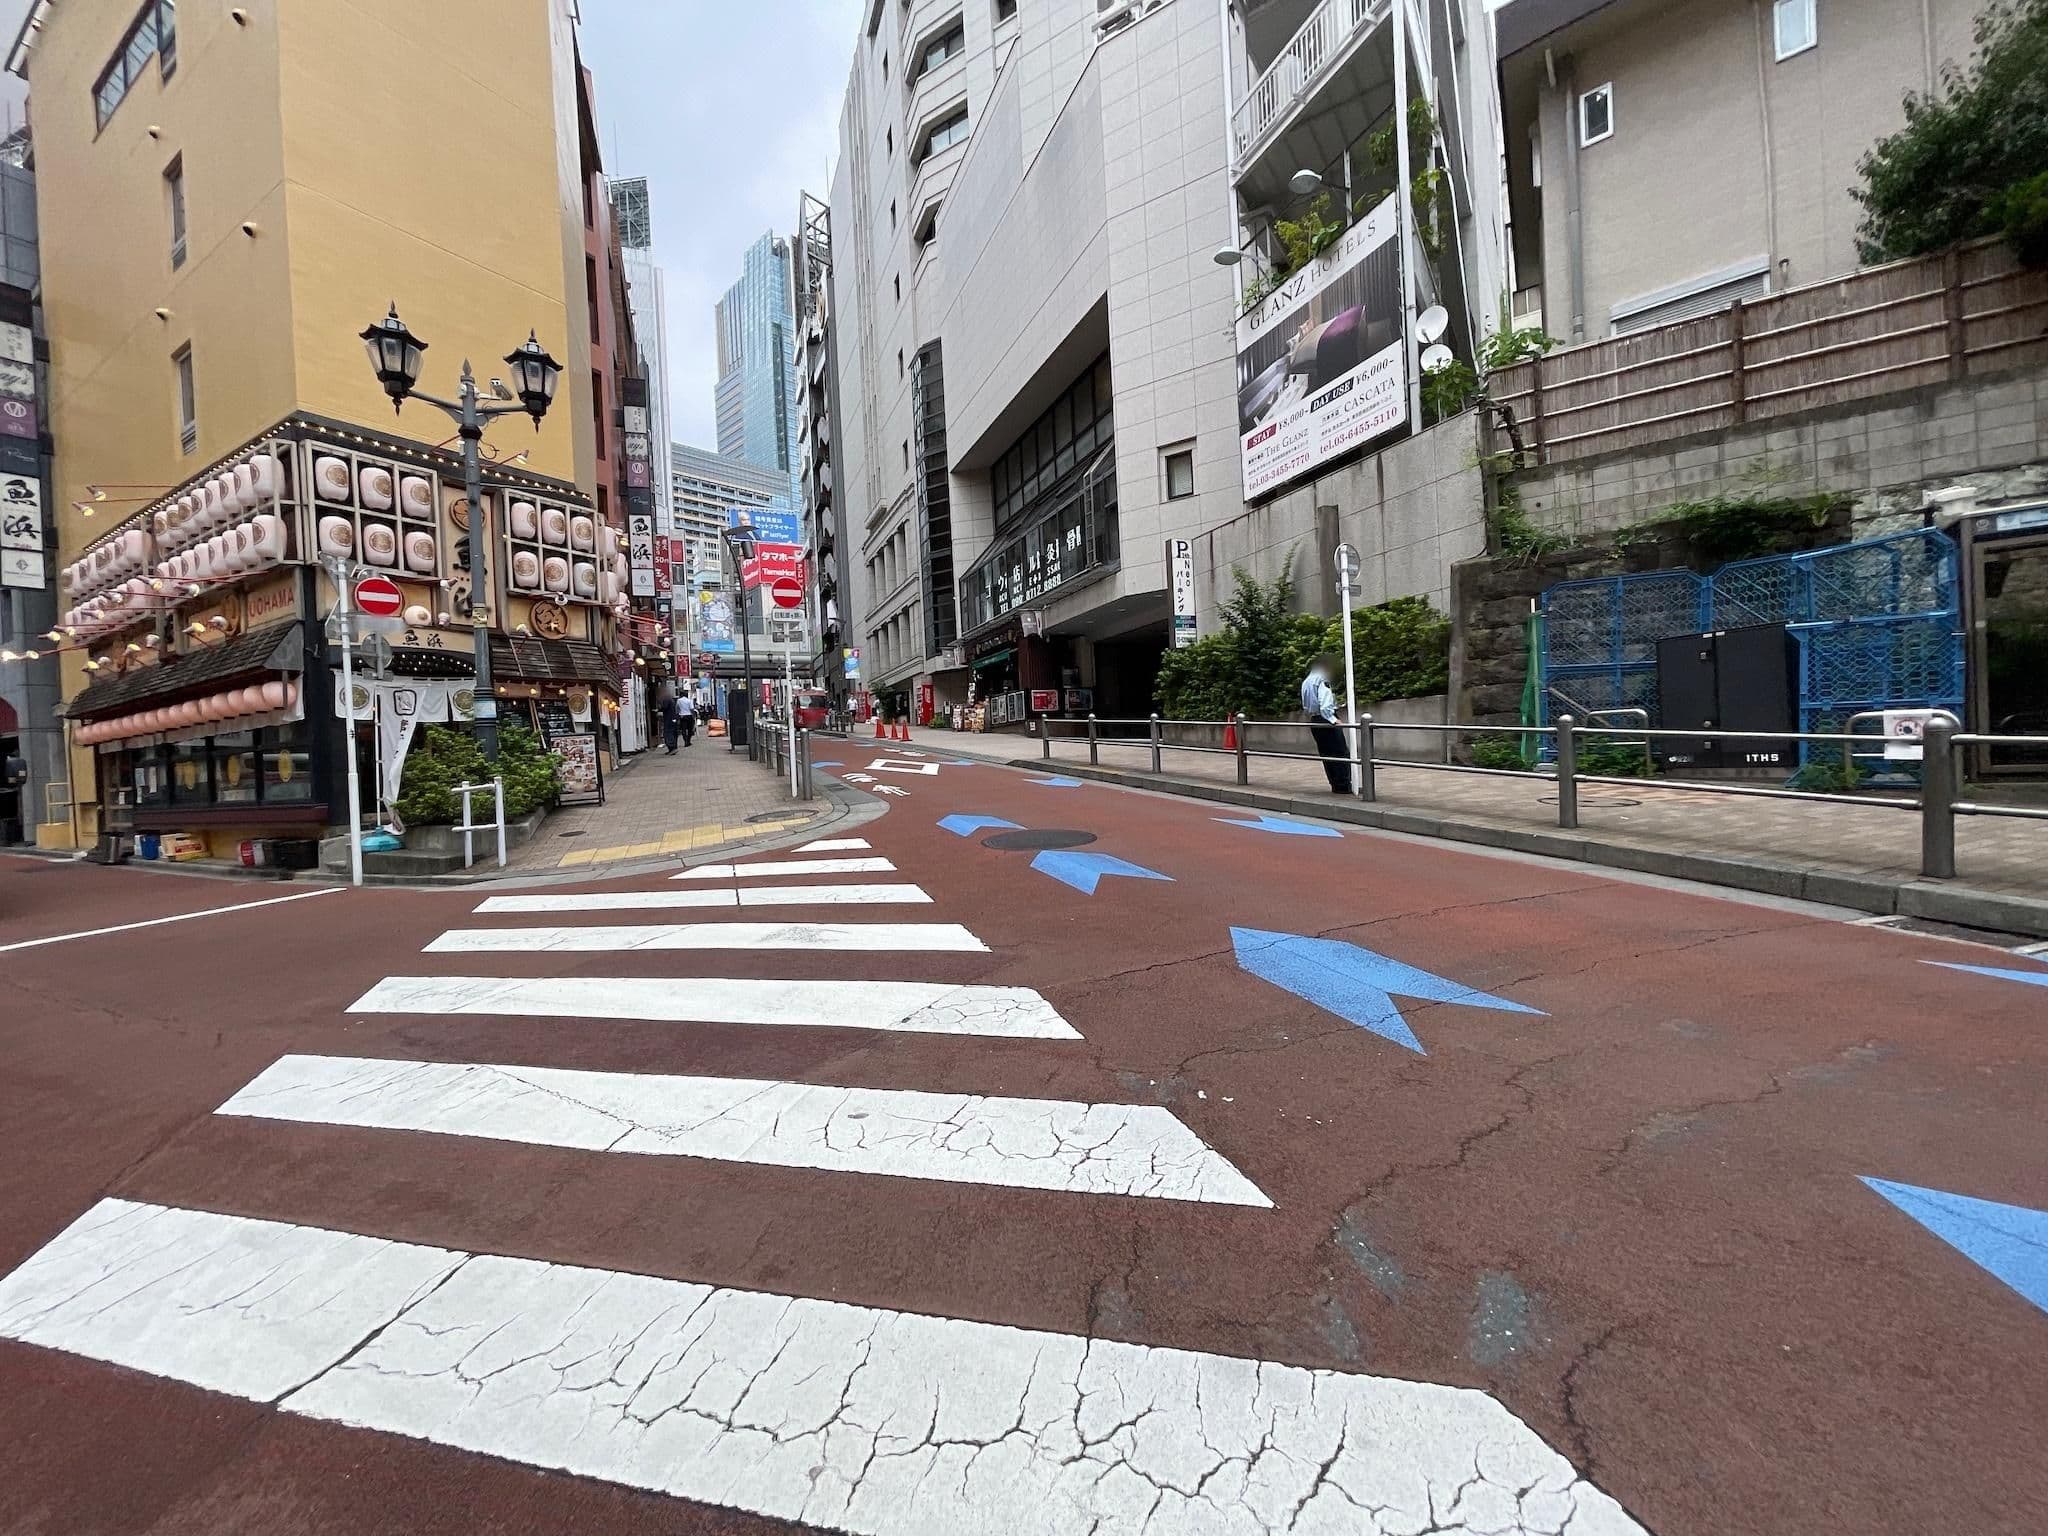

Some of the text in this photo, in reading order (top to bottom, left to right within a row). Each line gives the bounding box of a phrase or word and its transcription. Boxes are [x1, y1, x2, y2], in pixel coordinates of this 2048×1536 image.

[1250, 275, 1305, 330] GLANZ
[1311, 220, 1376, 282] HOTELS
[1313, 393, 1331, 408] DAY
[1332, 381, 1351, 399] USE
[1344, 377, 1395, 412] CASCATA
[761, 550, 796, 562] タマホー
[248, 586, 294, 618] UOHAMA
